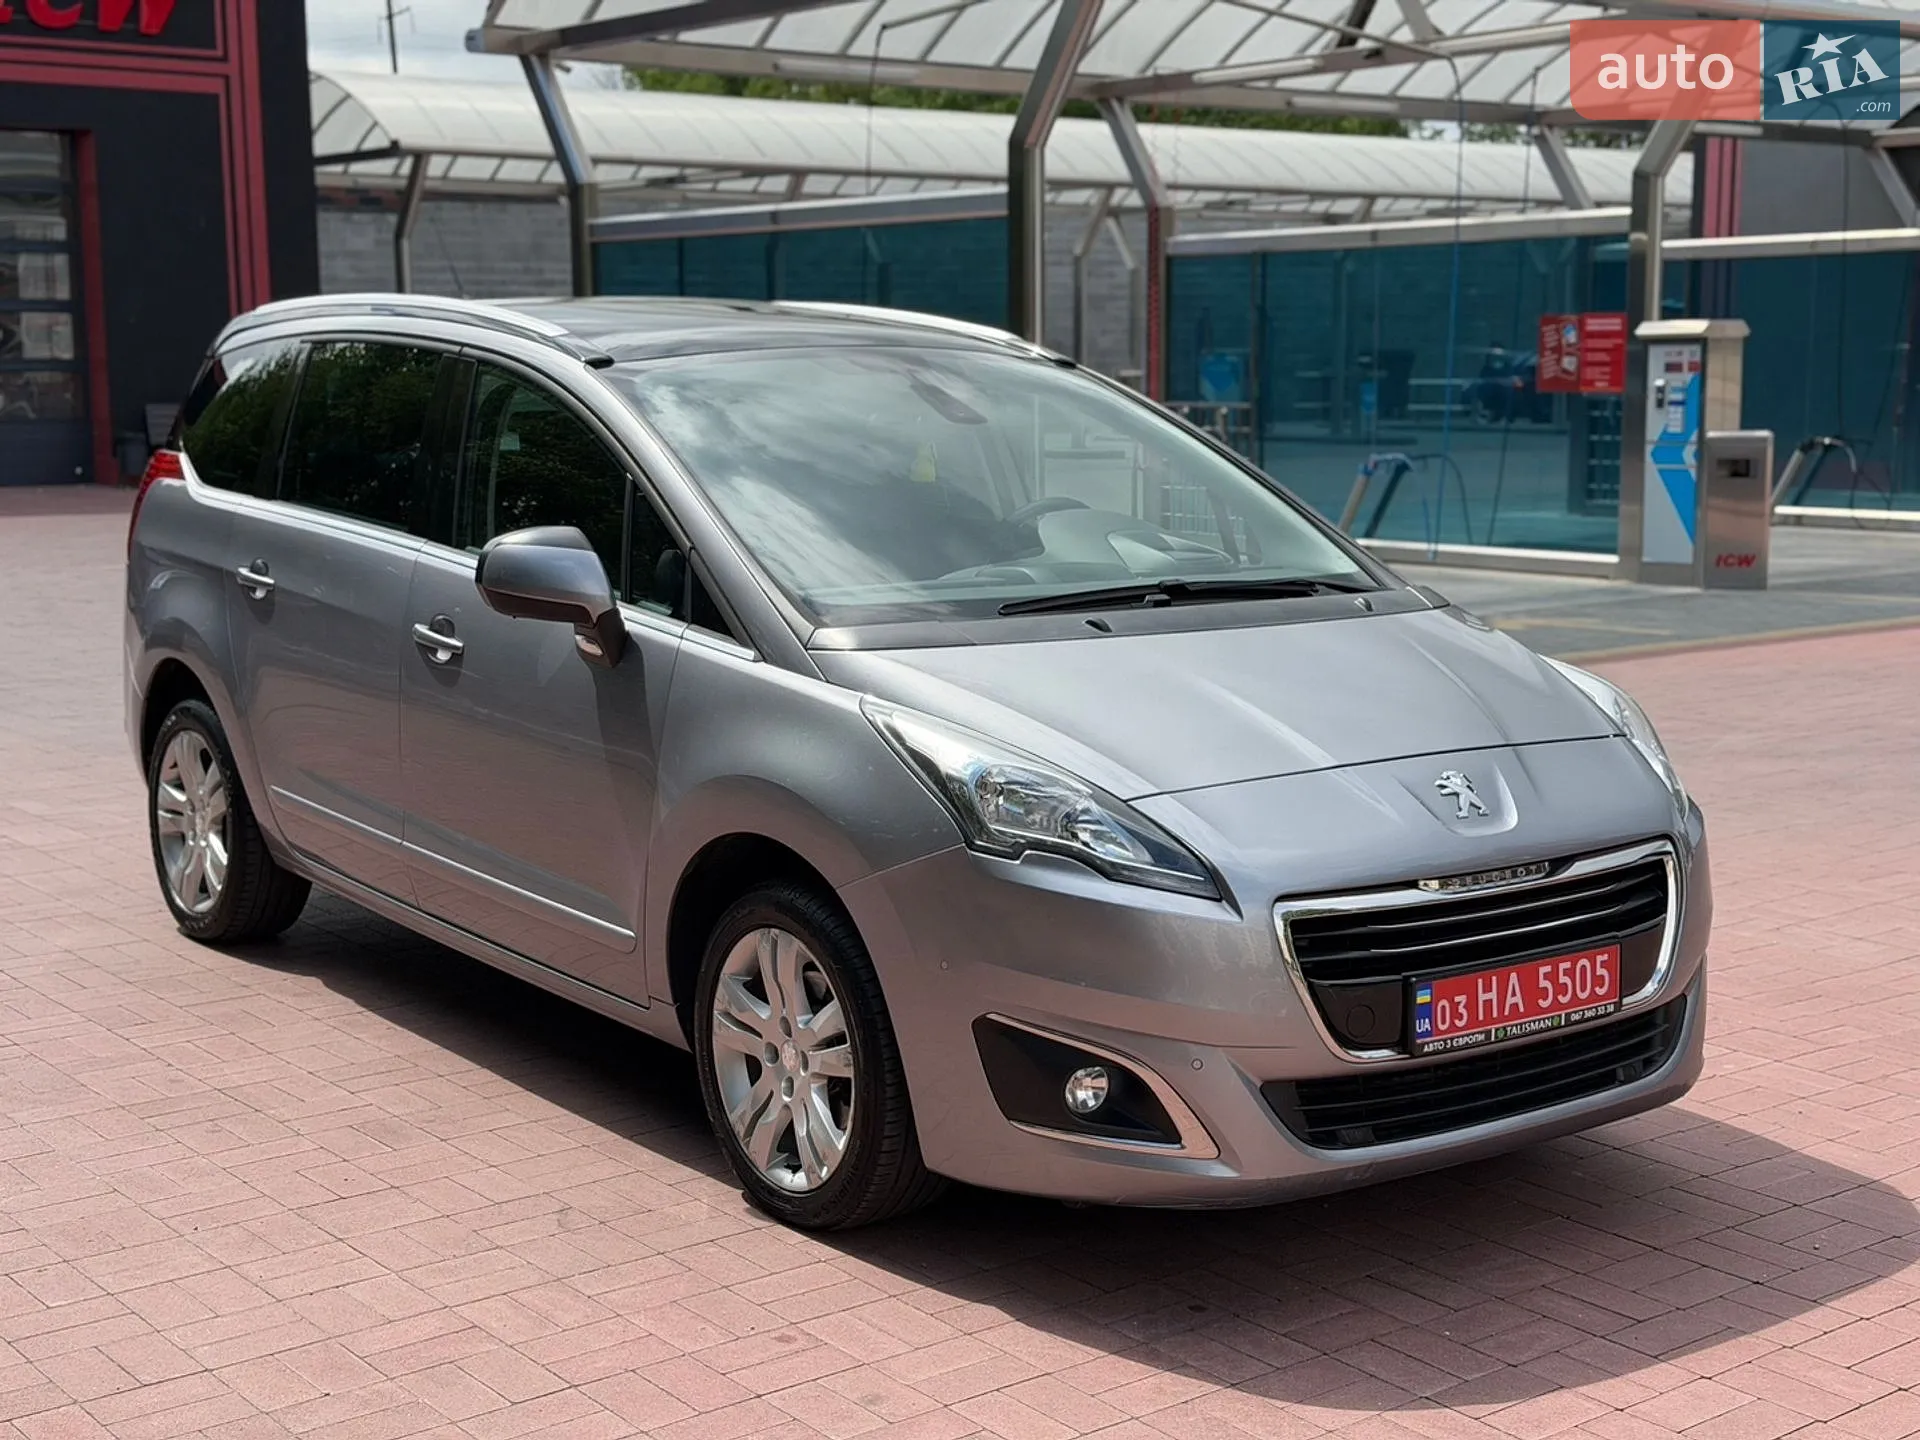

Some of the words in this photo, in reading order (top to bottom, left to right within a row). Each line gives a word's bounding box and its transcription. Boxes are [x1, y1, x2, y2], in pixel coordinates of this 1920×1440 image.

[1437, 994, 1468, 1031] 03
[1537, 953, 1610, 1008] 5505
[1416, 1018, 1431, 1032] UA
[1506, 1018, 1551, 1035] TALISMAN
